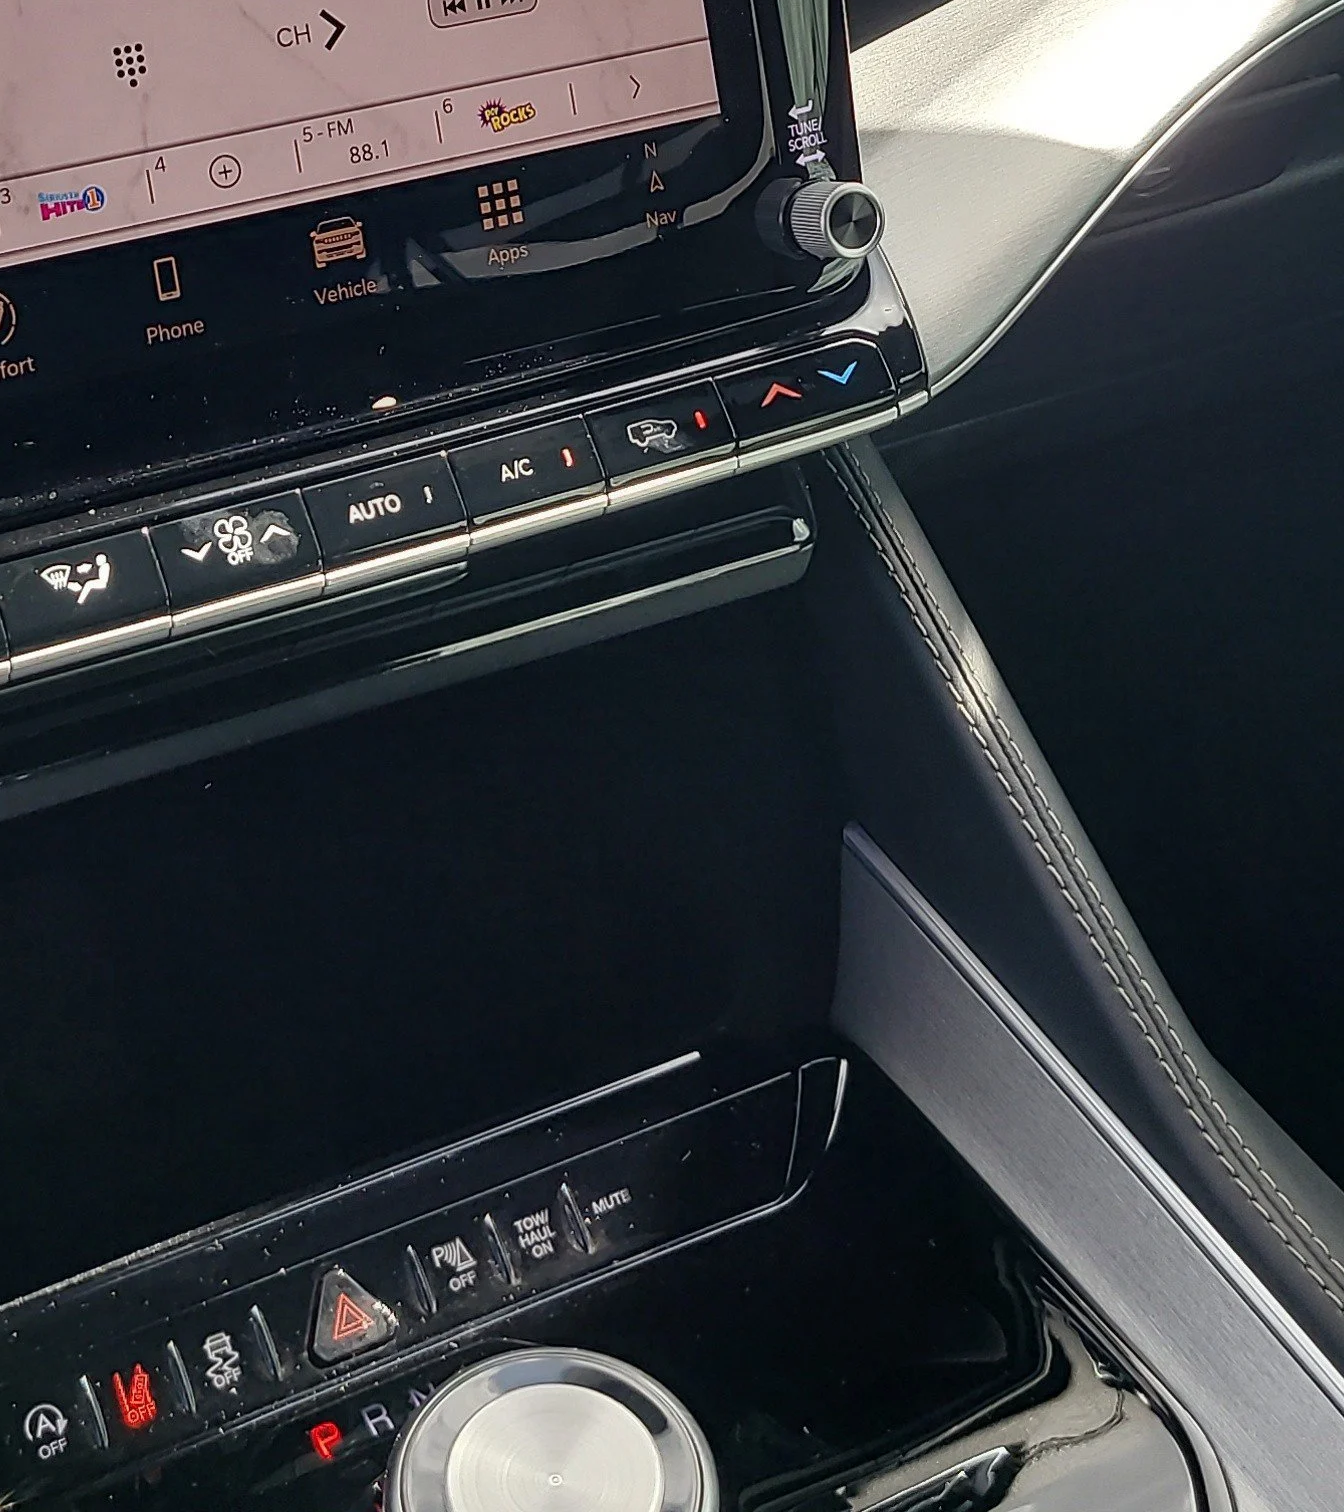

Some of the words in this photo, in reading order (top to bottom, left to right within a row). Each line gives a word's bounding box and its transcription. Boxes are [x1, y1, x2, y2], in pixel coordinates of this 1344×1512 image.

[276, 25, 312, 48] CH
[442, 98, 454, 114] 6
[491, 103, 535, 133] ROCKS
[788, 116, 822, 137] TUNE/
[349, 139, 390, 164] 88.1
[644, 143, 657, 159] N
[788, 132, 828, 153] SCROLL
[153, 156, 166, 175] 4
[0, 187, 12, 205] 3
[646, 206, 677, 228] Nav
[487, 241, 529, 269] Apps
[313, 276, 378, 305] Vehicle
[146, 315, 205, 347] Phone
[499, 458, 535, 483] A/C
[347, 493, 402, 525] AUTO
[226, 545, 254, 566] OFF
[591, 1187, 633, 1215] MUTE
[514, 1208, 549, 1233] TOW/
[519, 1227, 556, 1250] HAUL
[532, 1241, 554, 1259] ON
[448, 1270, 477, 1292] OFF
[212, 1368, 242, 1389] OFF
[127, 1401, 156, 1423] OFF
[311, 1421, 342, 1461] P
[361, 1403, 395, 1437] R
[38, 1438, 68, 1461] OFF
